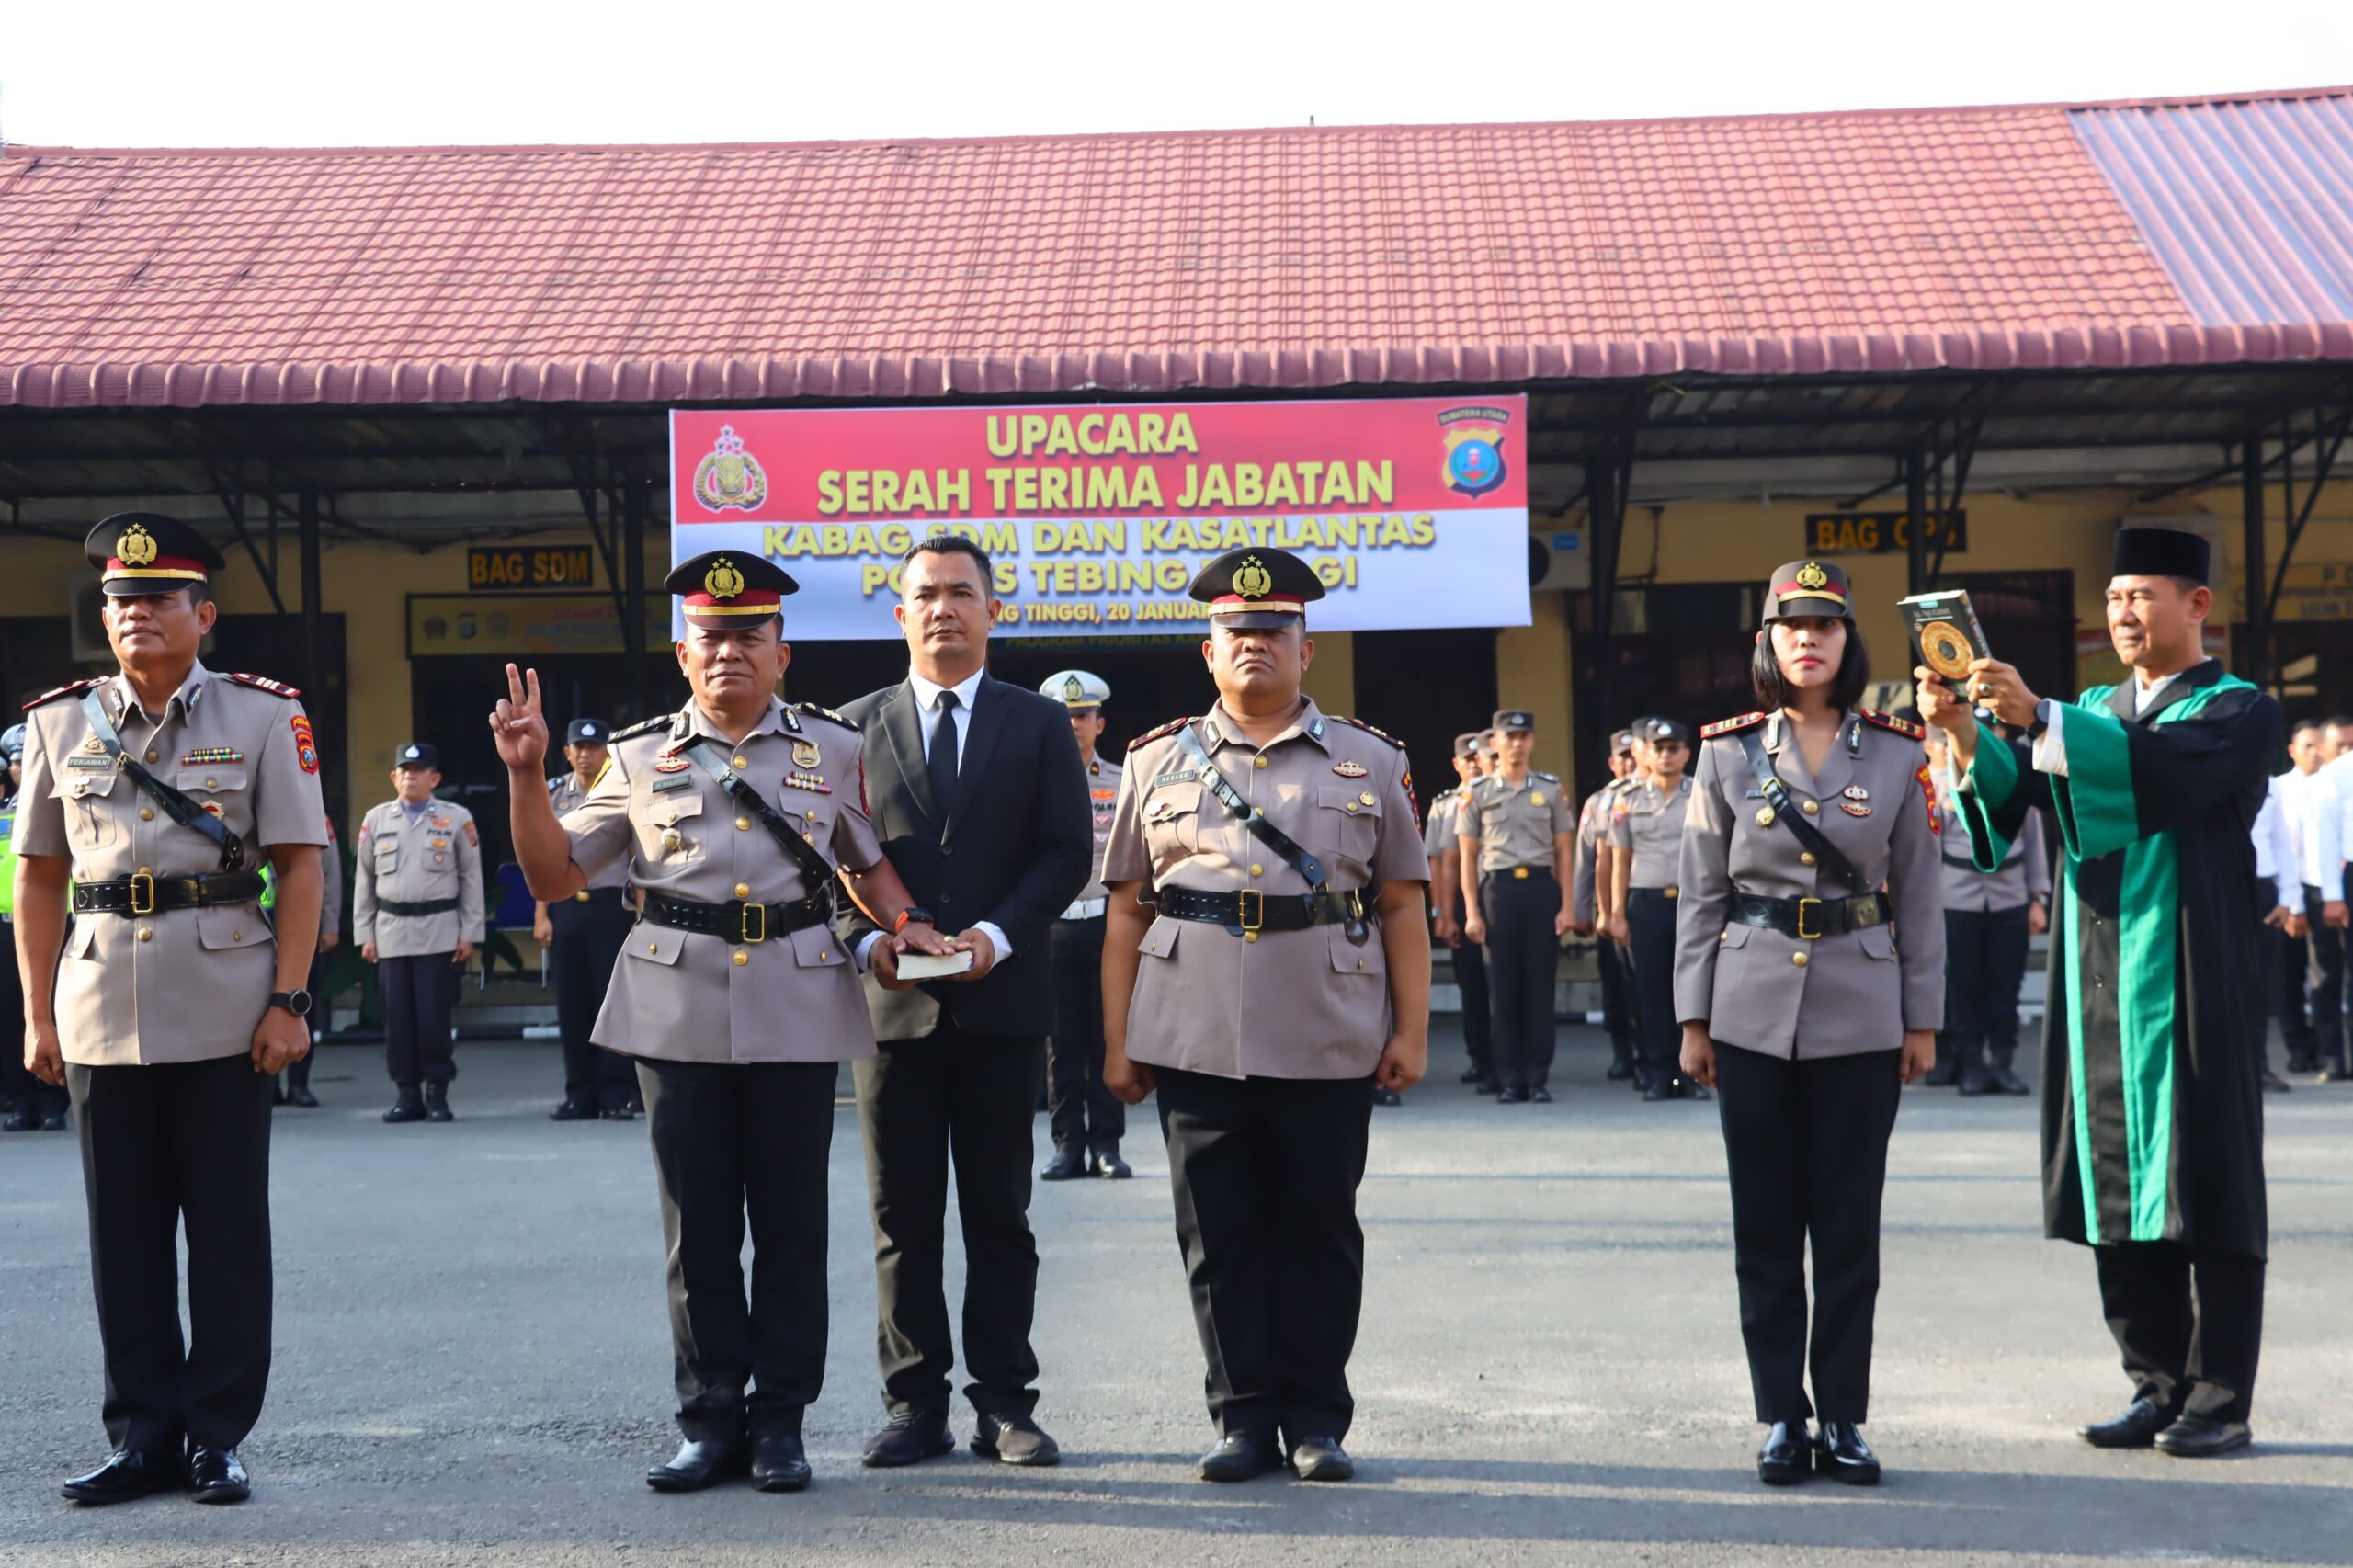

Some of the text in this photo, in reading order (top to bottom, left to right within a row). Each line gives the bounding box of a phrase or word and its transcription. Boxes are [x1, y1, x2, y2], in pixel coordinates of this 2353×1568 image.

[986, 413, 1198, 456] UPACARA
[817, 460, 1393, 513] SERAH TERIMA JABATAN
[763, 523, 913, 556] KABAG
[1033, 520, 1125, 551] DAN
[1142, 515, 1435, 550] KASATLANTAS
[1816, 518, 1879, 550] BAG
[472, 551, 588, 583] BAG SDM
[1030, 555, 1188, 591] TEBING
[1025, 603, 1101, 623] TINGGI,
[1107, 603, 1130, 619] 20
